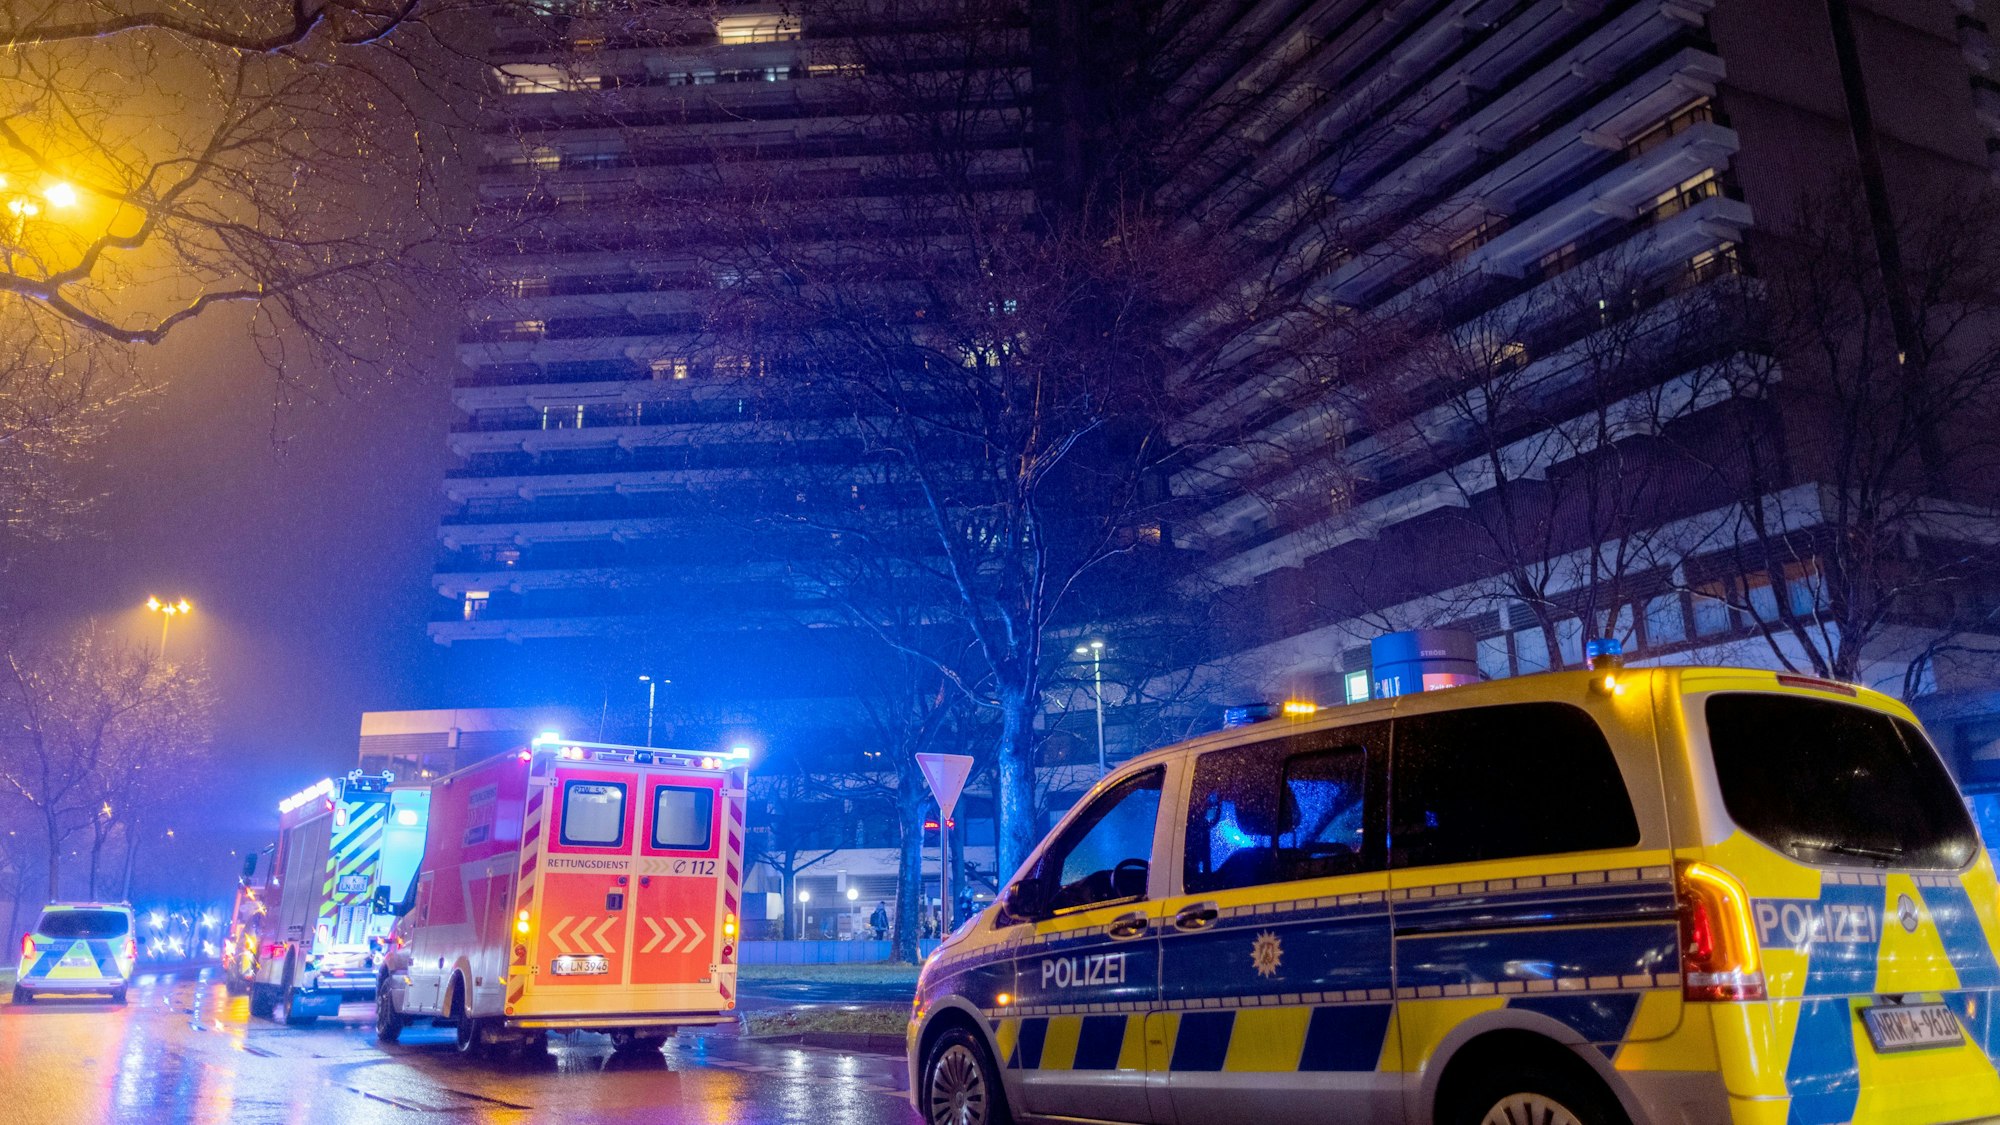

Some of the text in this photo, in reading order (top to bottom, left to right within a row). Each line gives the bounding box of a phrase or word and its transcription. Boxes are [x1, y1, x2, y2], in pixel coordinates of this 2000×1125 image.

[1420, 649, 1447, 657] STRÖER
[547, 858, 629, 870] RETTUNGSDIENST
[690, 860, 716, 875] 112
[1755, 903, 1877, 944] POLIZEI
[557, 962, 564, 971] K
[570, 962, 583, 971] LN
[1041, 952, 1126, 989] POLIZEI
[1873, 1011, 1907, 1042] NRW
